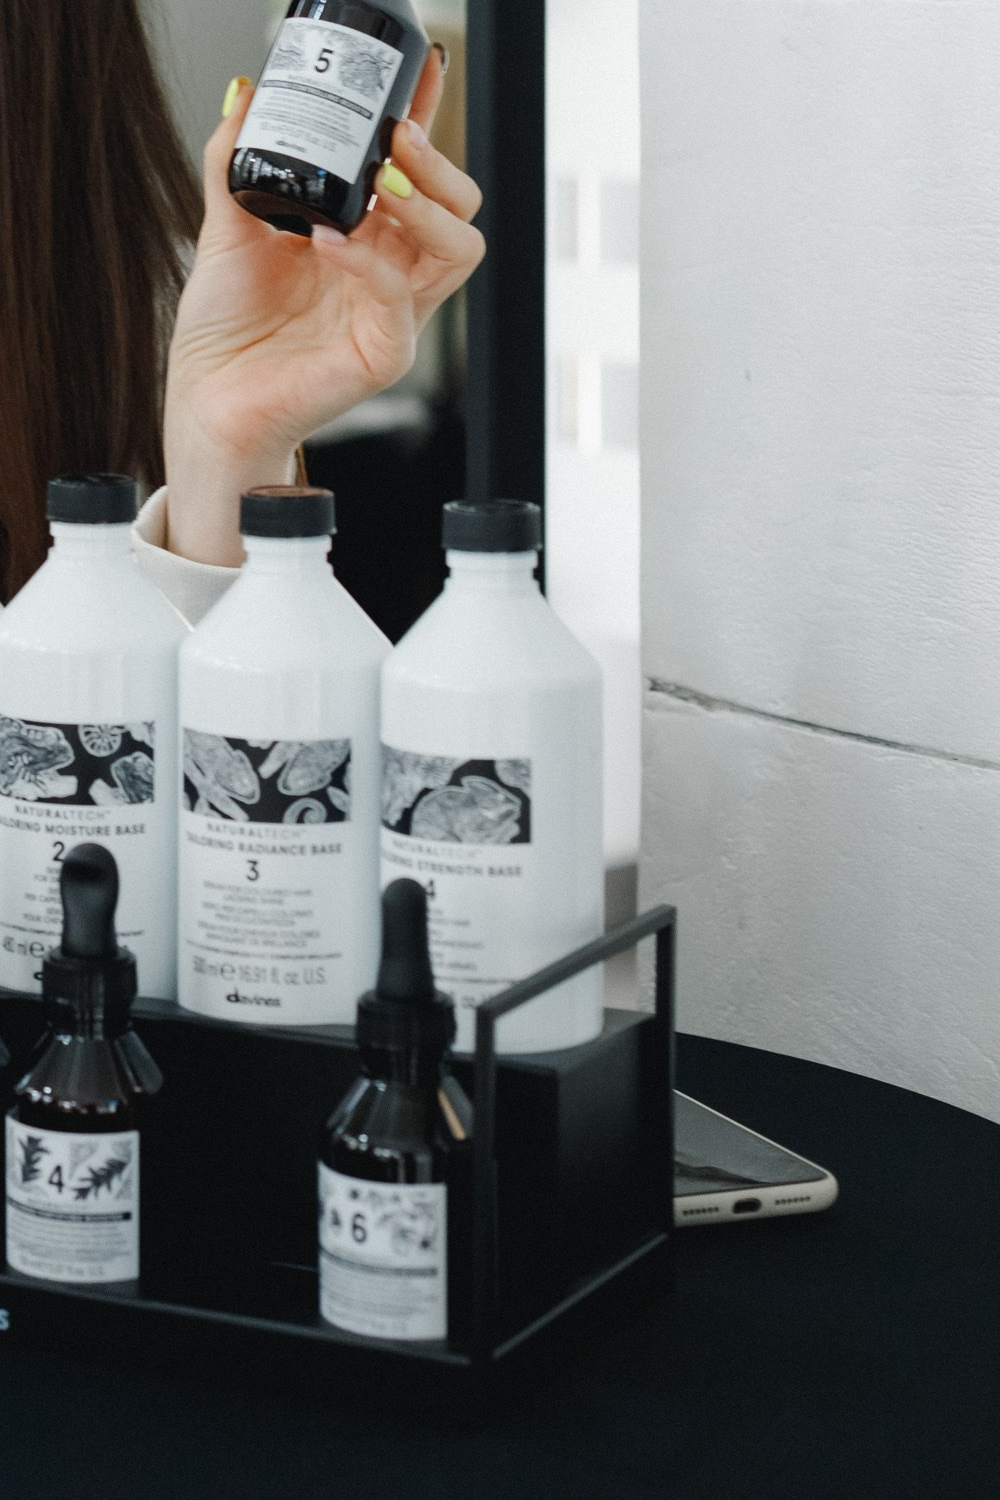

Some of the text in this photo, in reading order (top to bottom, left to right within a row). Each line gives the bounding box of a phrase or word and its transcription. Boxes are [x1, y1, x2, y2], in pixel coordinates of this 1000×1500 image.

[314, 48, 334, 73] 5
[44, 823, 110, 837] MOISTURE
[115, 823, 147, 835] BASE
[53, 841, 65, 862] 2
[238, 841, 306, 856] RADIANCE
[311, 843, 342, 855] BASE
[246, 860, 259, 882] 3
[488, 866, 522, 877] BASE
[226, 986, 281, 1007] davines
[48, 1165, 65, 1194] 4
[352, 1213, 367, 1244] 6
